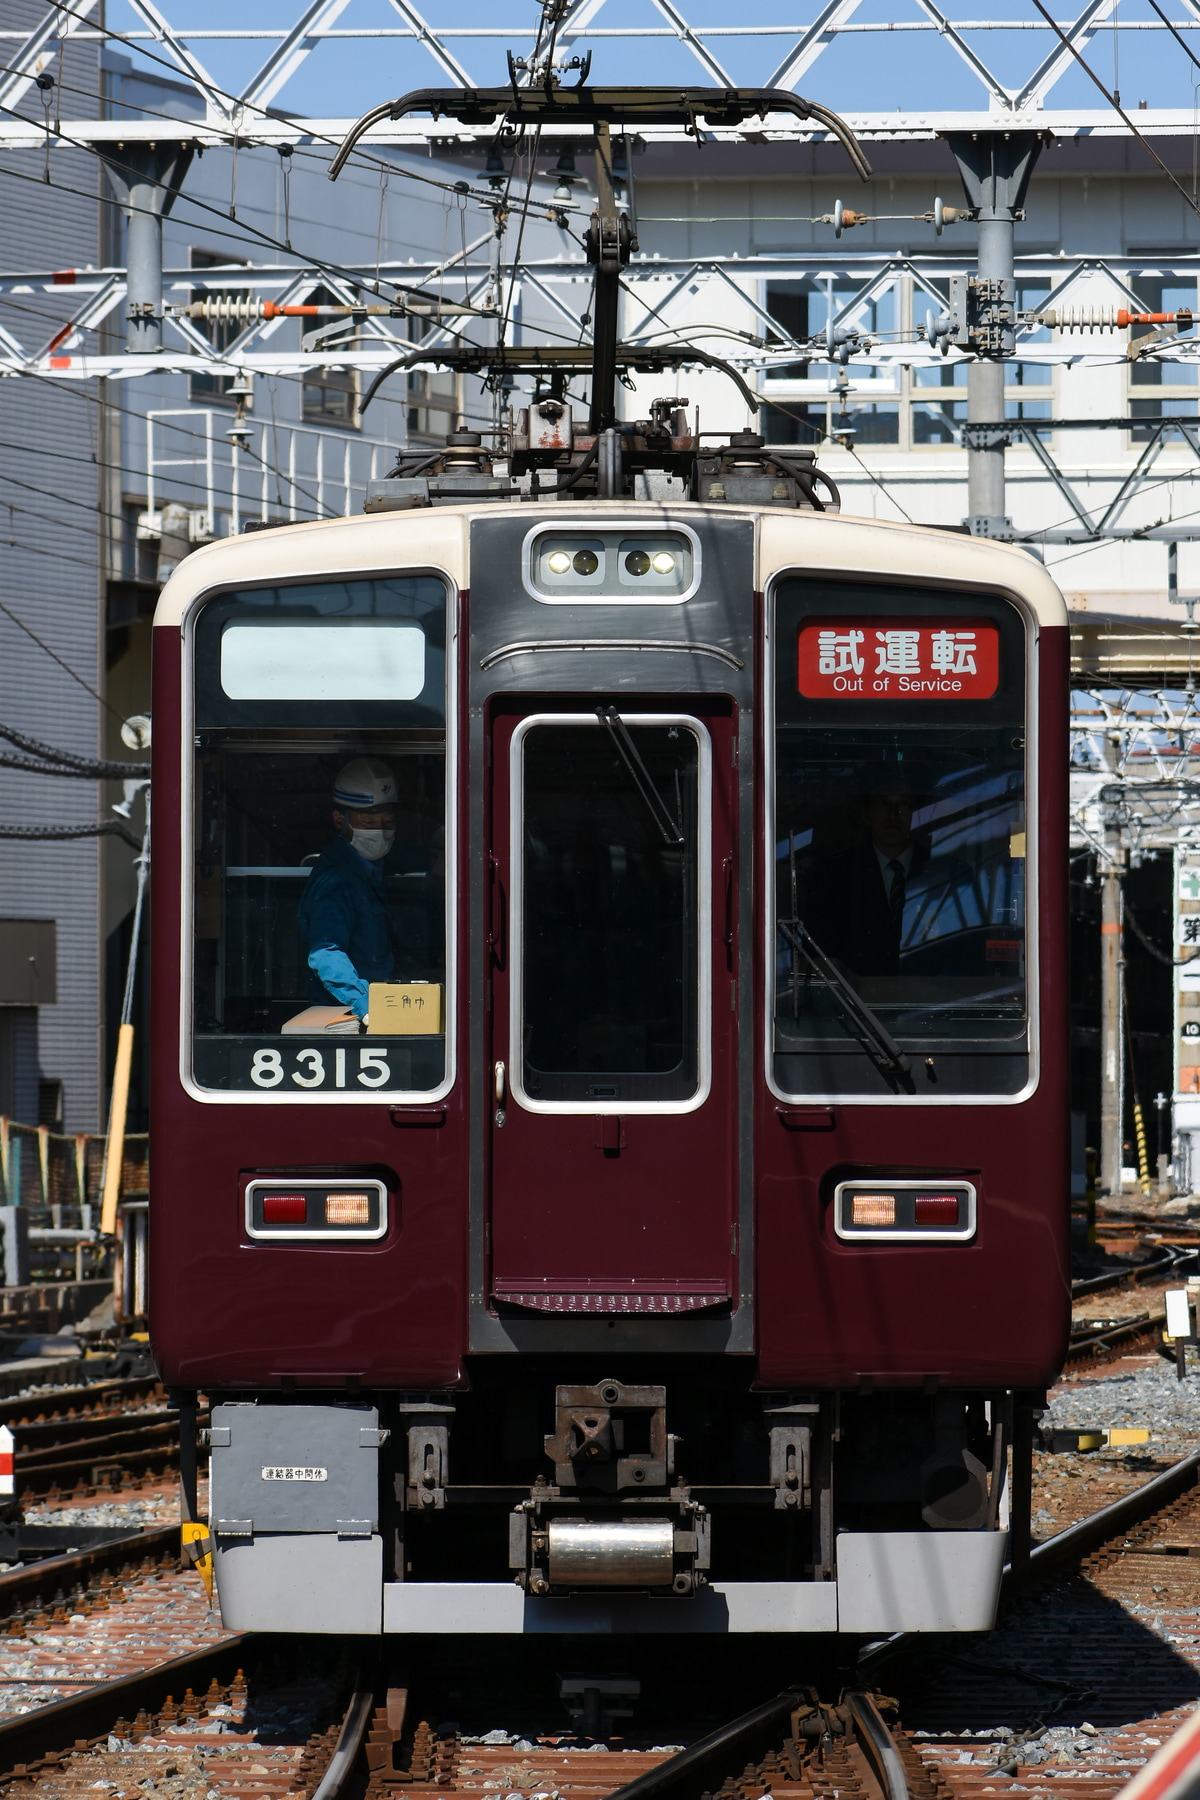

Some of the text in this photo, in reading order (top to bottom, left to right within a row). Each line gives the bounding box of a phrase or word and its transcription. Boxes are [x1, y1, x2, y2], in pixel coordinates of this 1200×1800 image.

[818, 630, 977, 675] 試運転
[833, 676, 962, 691] Out of Service
[250, 1048, 391, 1088] 8315
